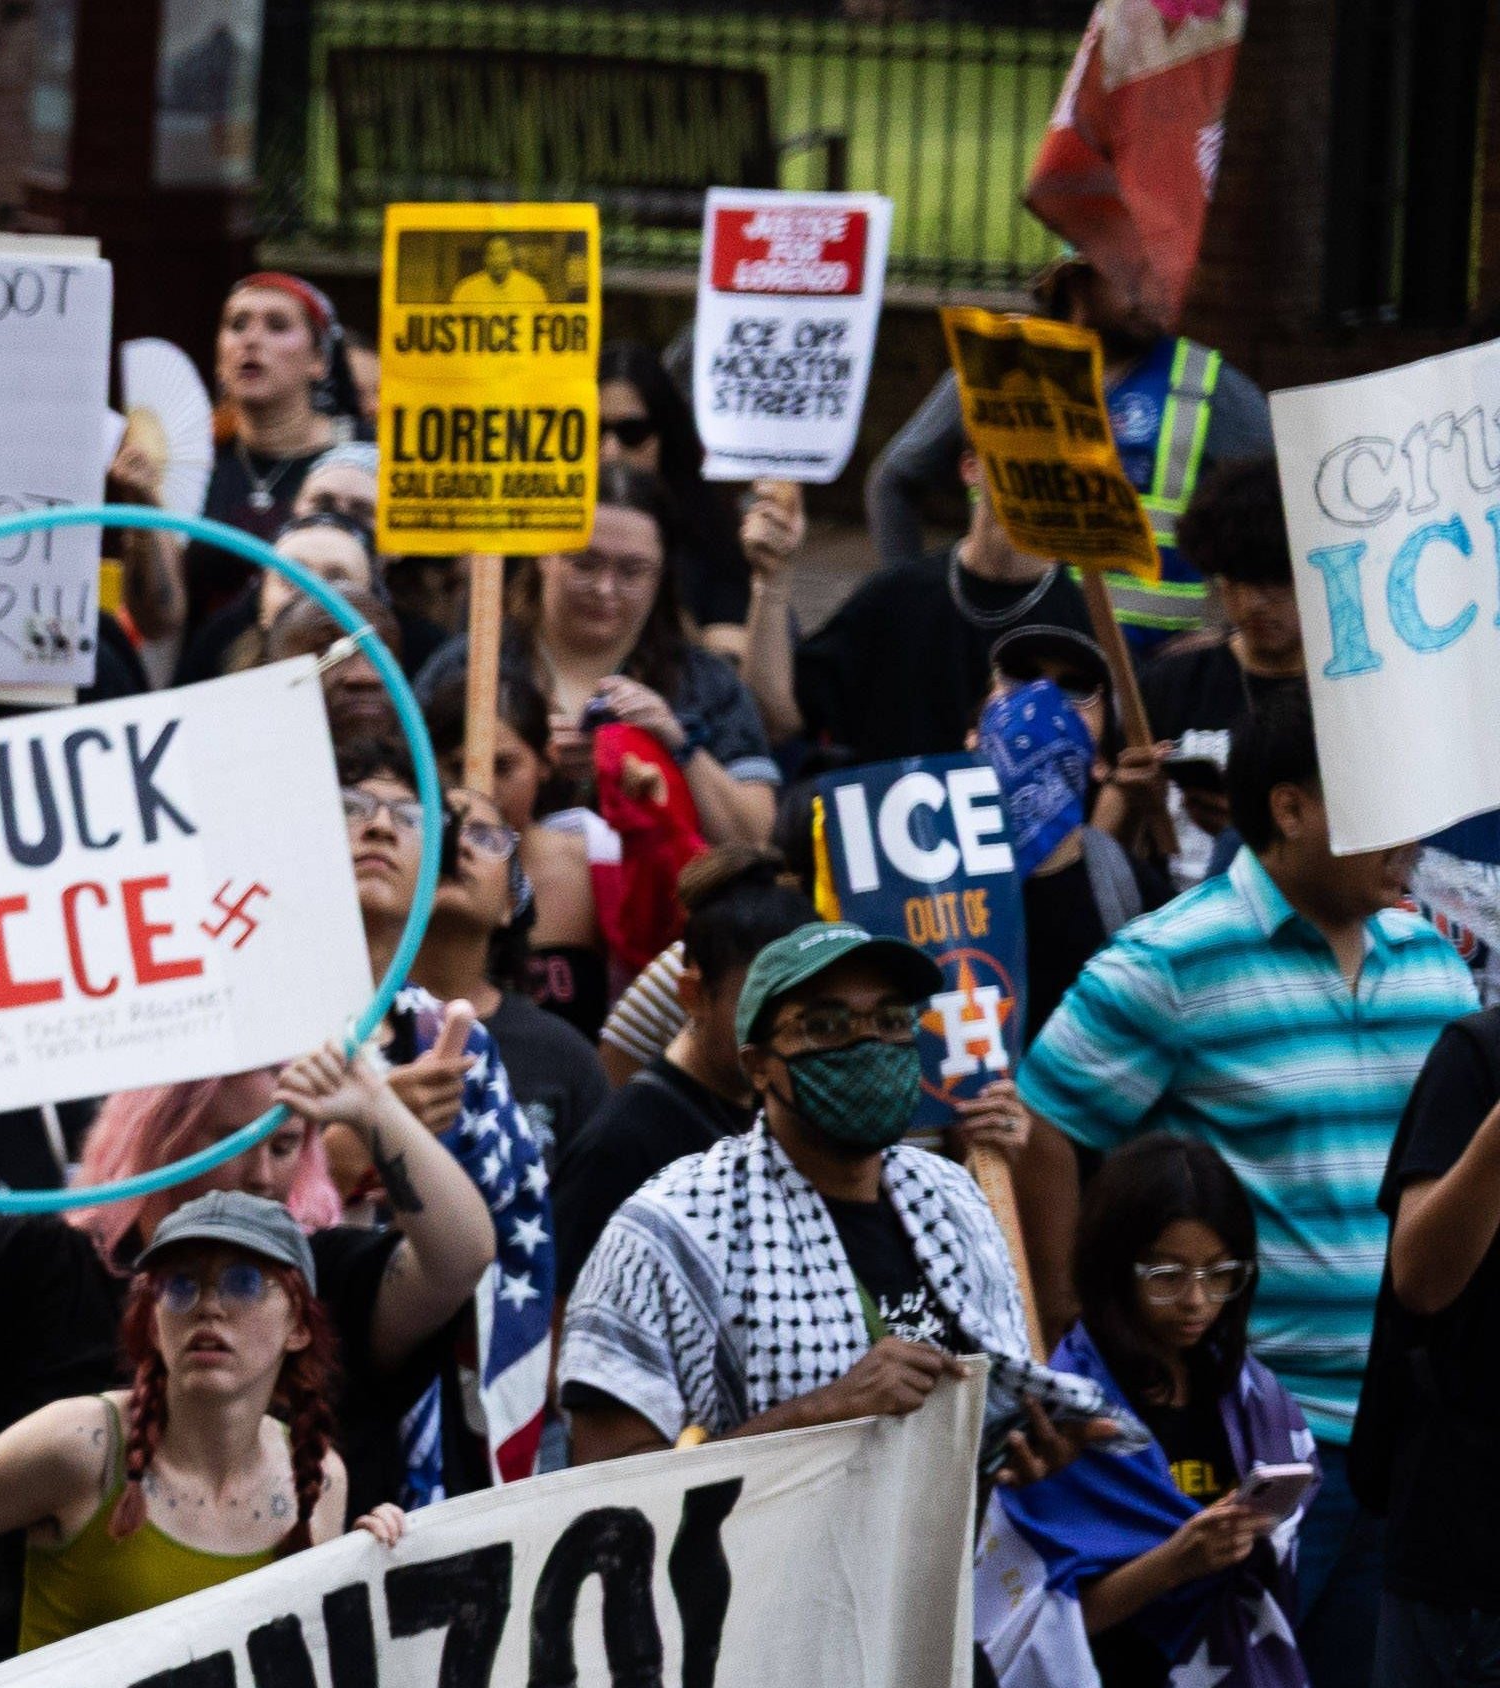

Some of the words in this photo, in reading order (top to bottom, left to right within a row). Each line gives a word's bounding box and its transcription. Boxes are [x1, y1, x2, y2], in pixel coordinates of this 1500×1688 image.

[394, 312, 521, 354] JUSTICE
[531, 314, 590, 354] FOR
[727, 317, 776, 347] ICE
[392, 406, 587, 466] LORENZO
[389, 471, 494, 501] SALGADO
[499, 470, 586, 500] ARAUJO
[833, 765, 1015, 894] ICE
[904, 890, 961, 947] OUT
[962, 887, 991, 940] OF
